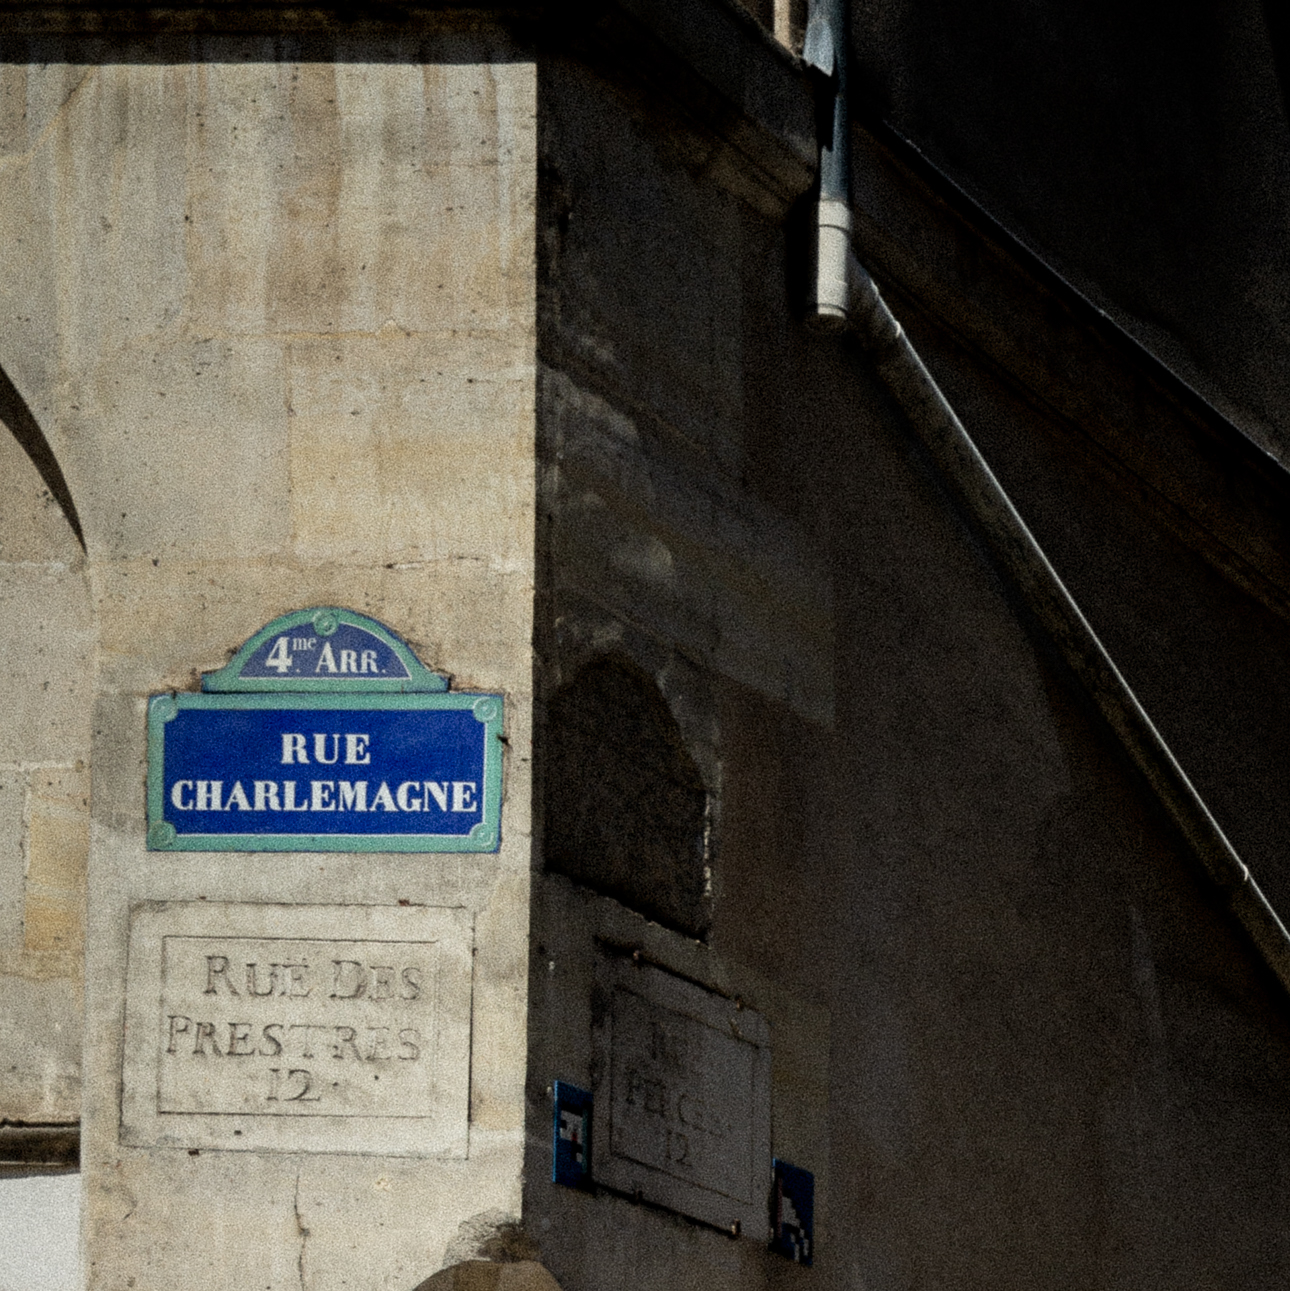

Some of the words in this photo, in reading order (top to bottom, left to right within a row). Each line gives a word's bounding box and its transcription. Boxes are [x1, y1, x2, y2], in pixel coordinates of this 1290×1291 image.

[280, 733, 371, 765] RUE
[170, 780, 478, 813] CHARLEMAGNE
[203, 955, 313, 999] RUE
[329, 959, 422, 1001] DES
[165, 1014, 421, 1060] PRESTRES
